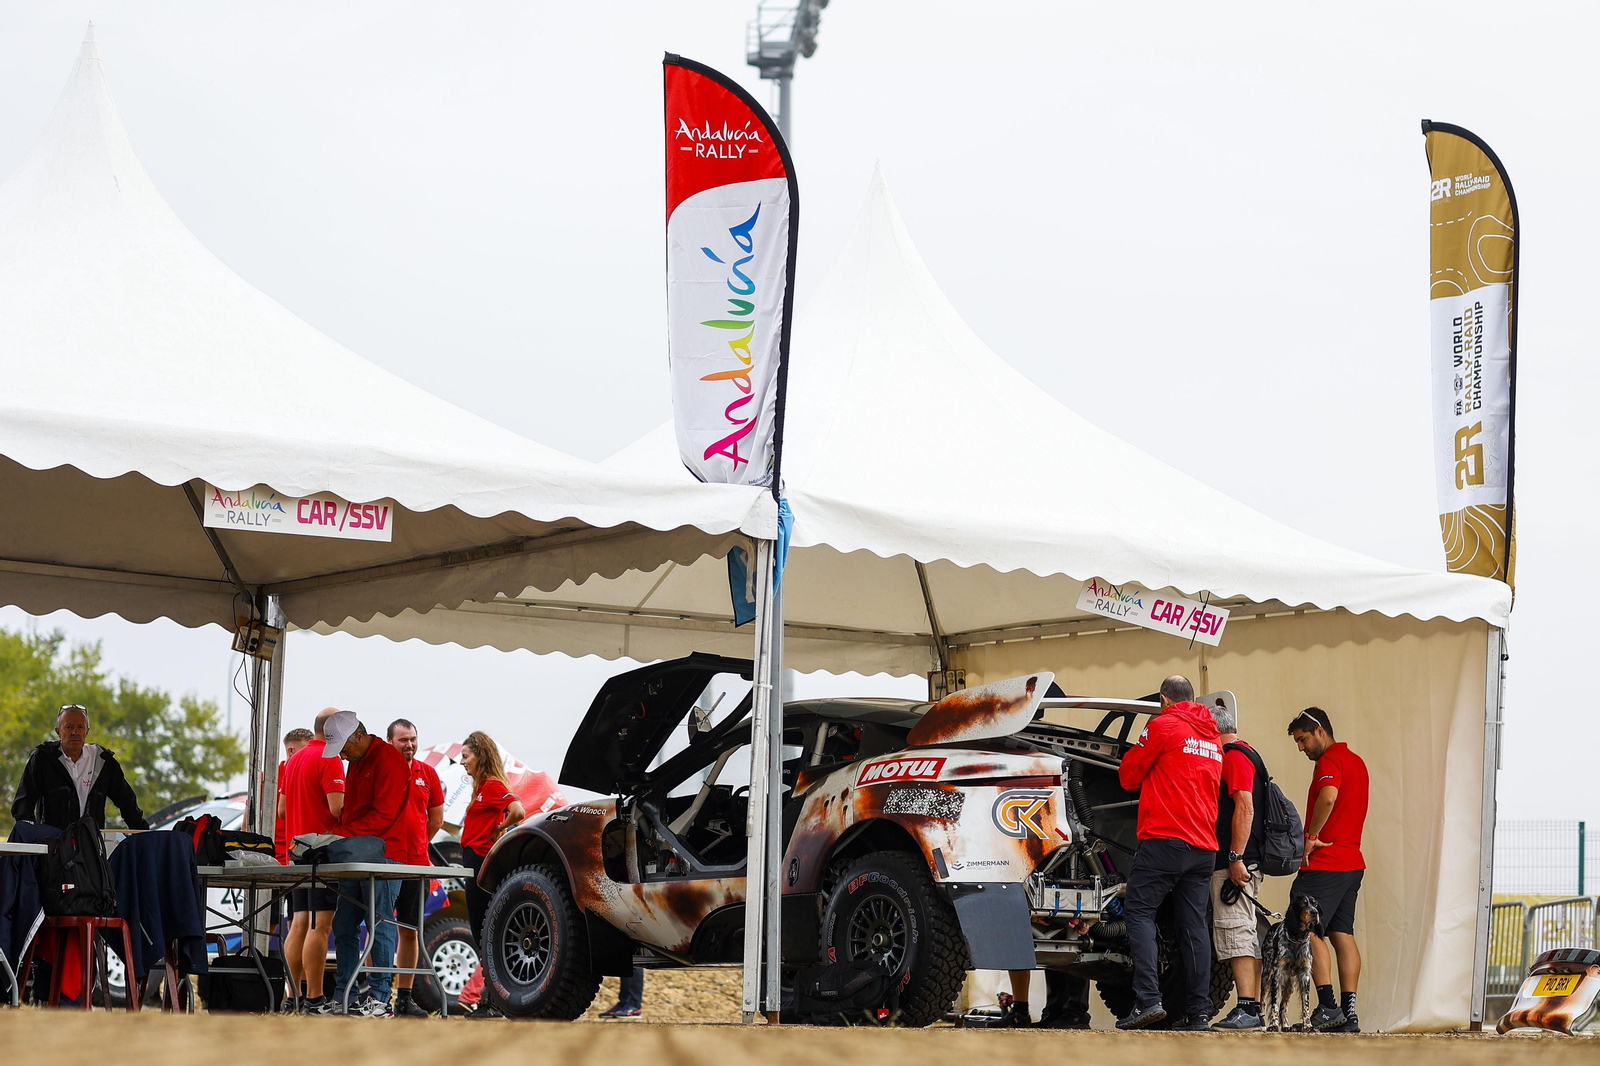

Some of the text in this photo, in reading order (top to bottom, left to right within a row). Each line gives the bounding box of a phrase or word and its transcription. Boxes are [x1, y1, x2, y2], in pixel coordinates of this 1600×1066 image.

[674, 117, 764, 143] Andalucía
[695, 142, 747, 159] RALLY
[1454, 173, 1473, 182] WORLD
[1454, 175, 1490, 190] RALLY-RAID
[1454, 182, 1492, 197] CHAMPIONSHIP
[700, 200, 761, 473] Andalucía
[1453, 316, 1463, 368] WORLD
[1464, 307, 1474, 414] RALLY-RAID
[1473, 301, 1484, 411] CHAMPIONSHIP
[211, 487, 287, 514] Andalucía
[226, 510, 272, 527] RALLY
[1094, 598, 1132, 617] RALLY
[1183, 746, 1200, 756] BRX
[862, 760, 939, 783] MOTUL
[848, 871, 919, 944] BFGoodrich
[1554, 977, 1573, 992] BRX
